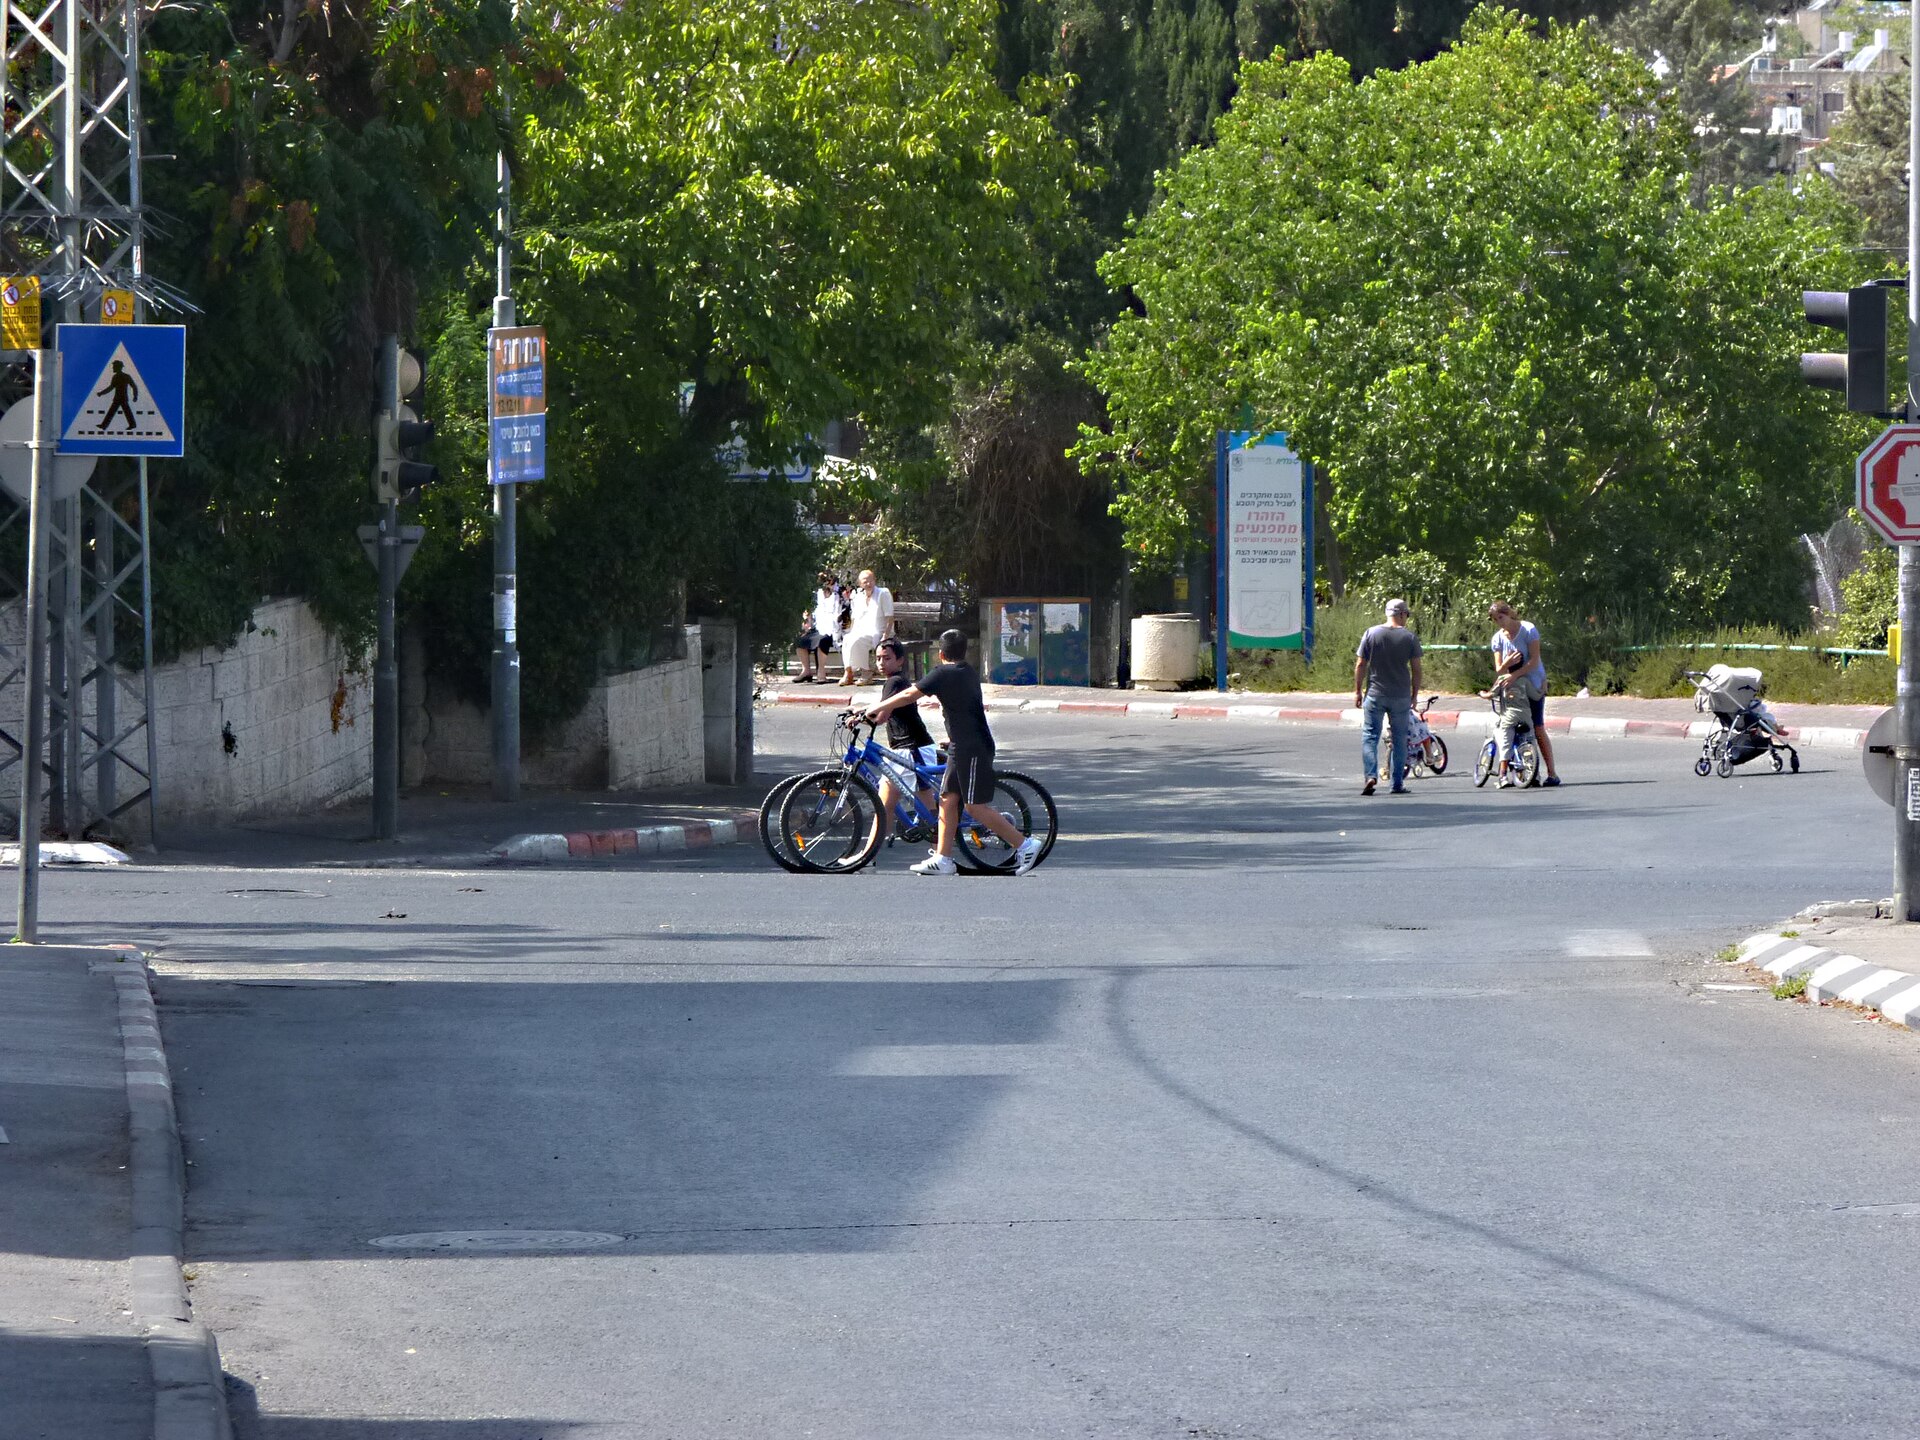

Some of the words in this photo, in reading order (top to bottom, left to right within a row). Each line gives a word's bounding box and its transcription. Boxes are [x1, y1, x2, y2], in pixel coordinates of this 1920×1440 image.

[502, 336, 540, 365] בחירות
[1240, 492, 1273, 500] מתקרבים
[1276, 499, 1297, 507] לשביל
[1247, 511, 1285, 521] הזהרו
[1235, 523, 1298, 534] ממפגעים
